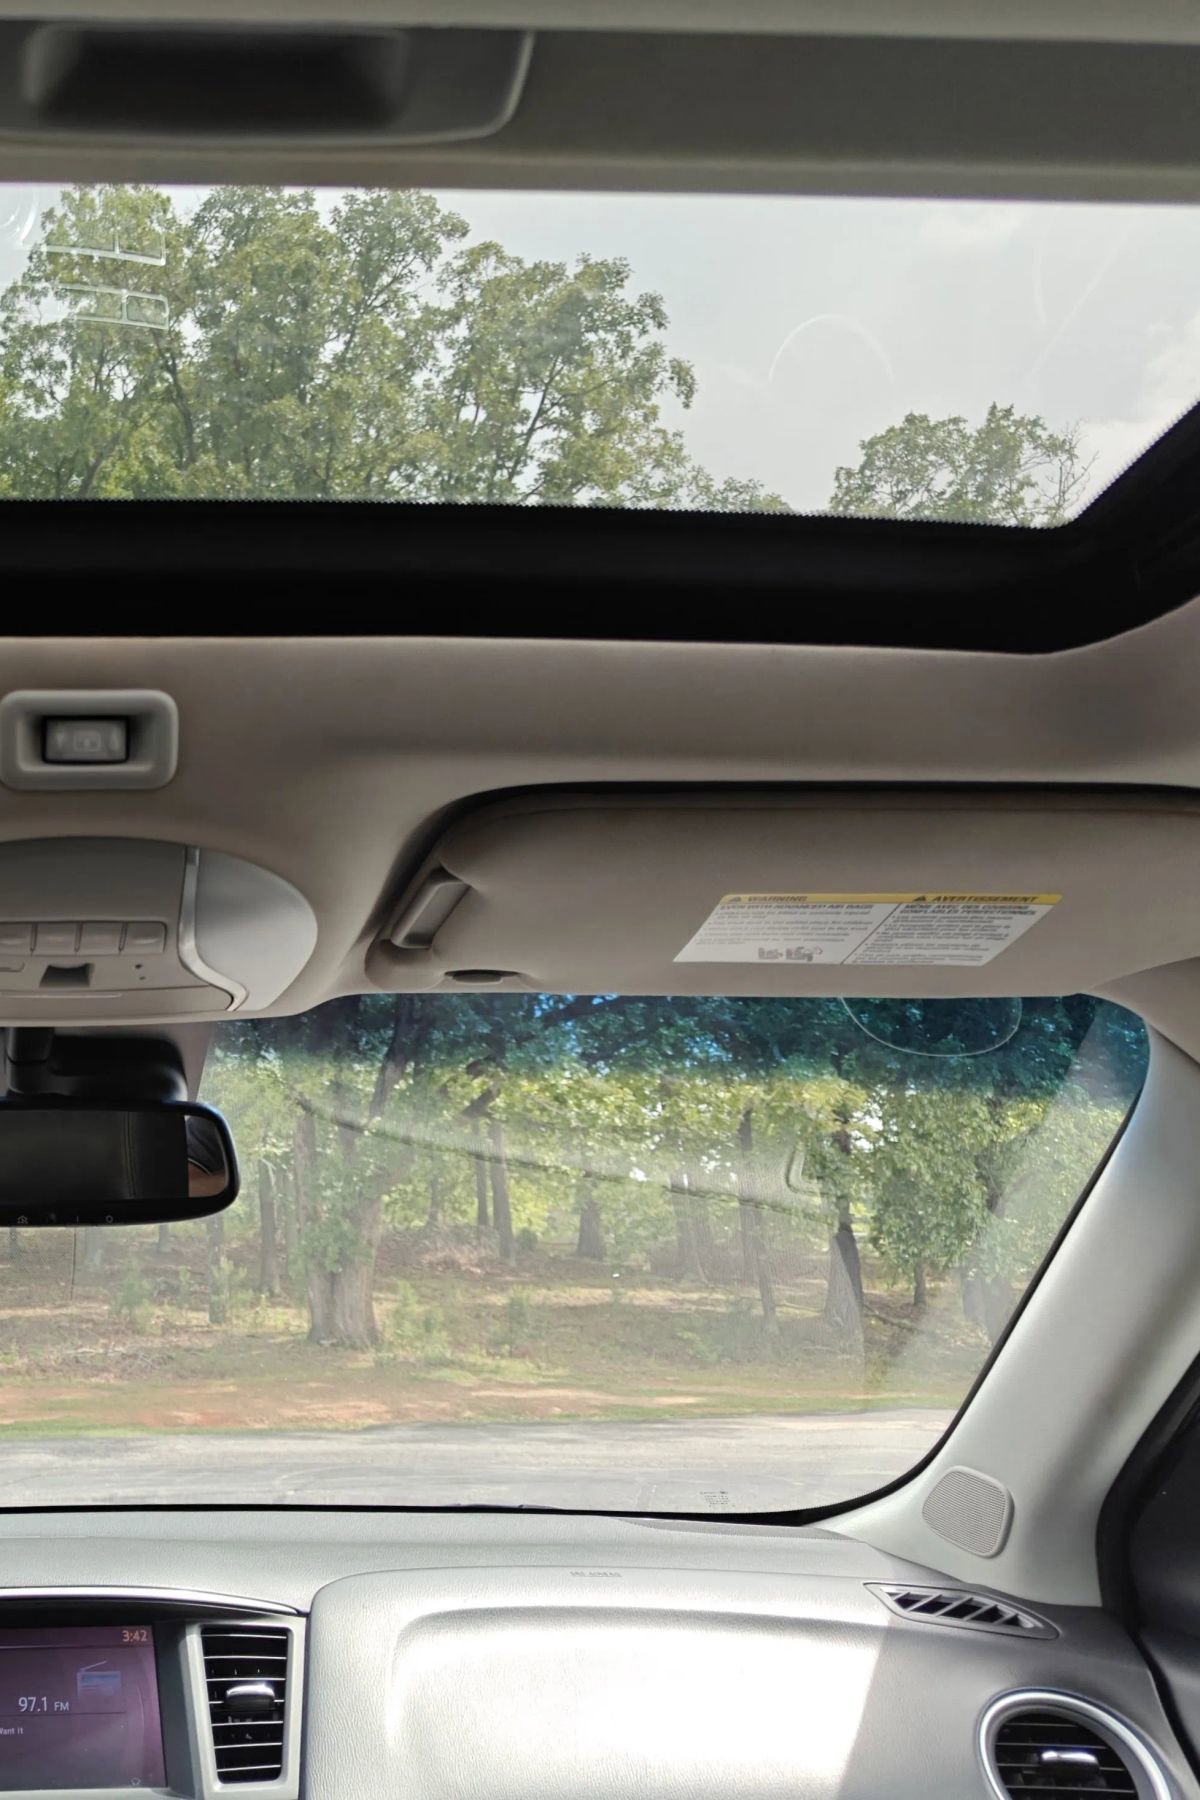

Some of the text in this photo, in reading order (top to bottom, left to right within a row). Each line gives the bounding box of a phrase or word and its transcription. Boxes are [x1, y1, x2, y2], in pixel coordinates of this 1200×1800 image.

[121, 1629, 148, 1642] 3:42
[18, 1697, 70, 1713] 97.1 FM
